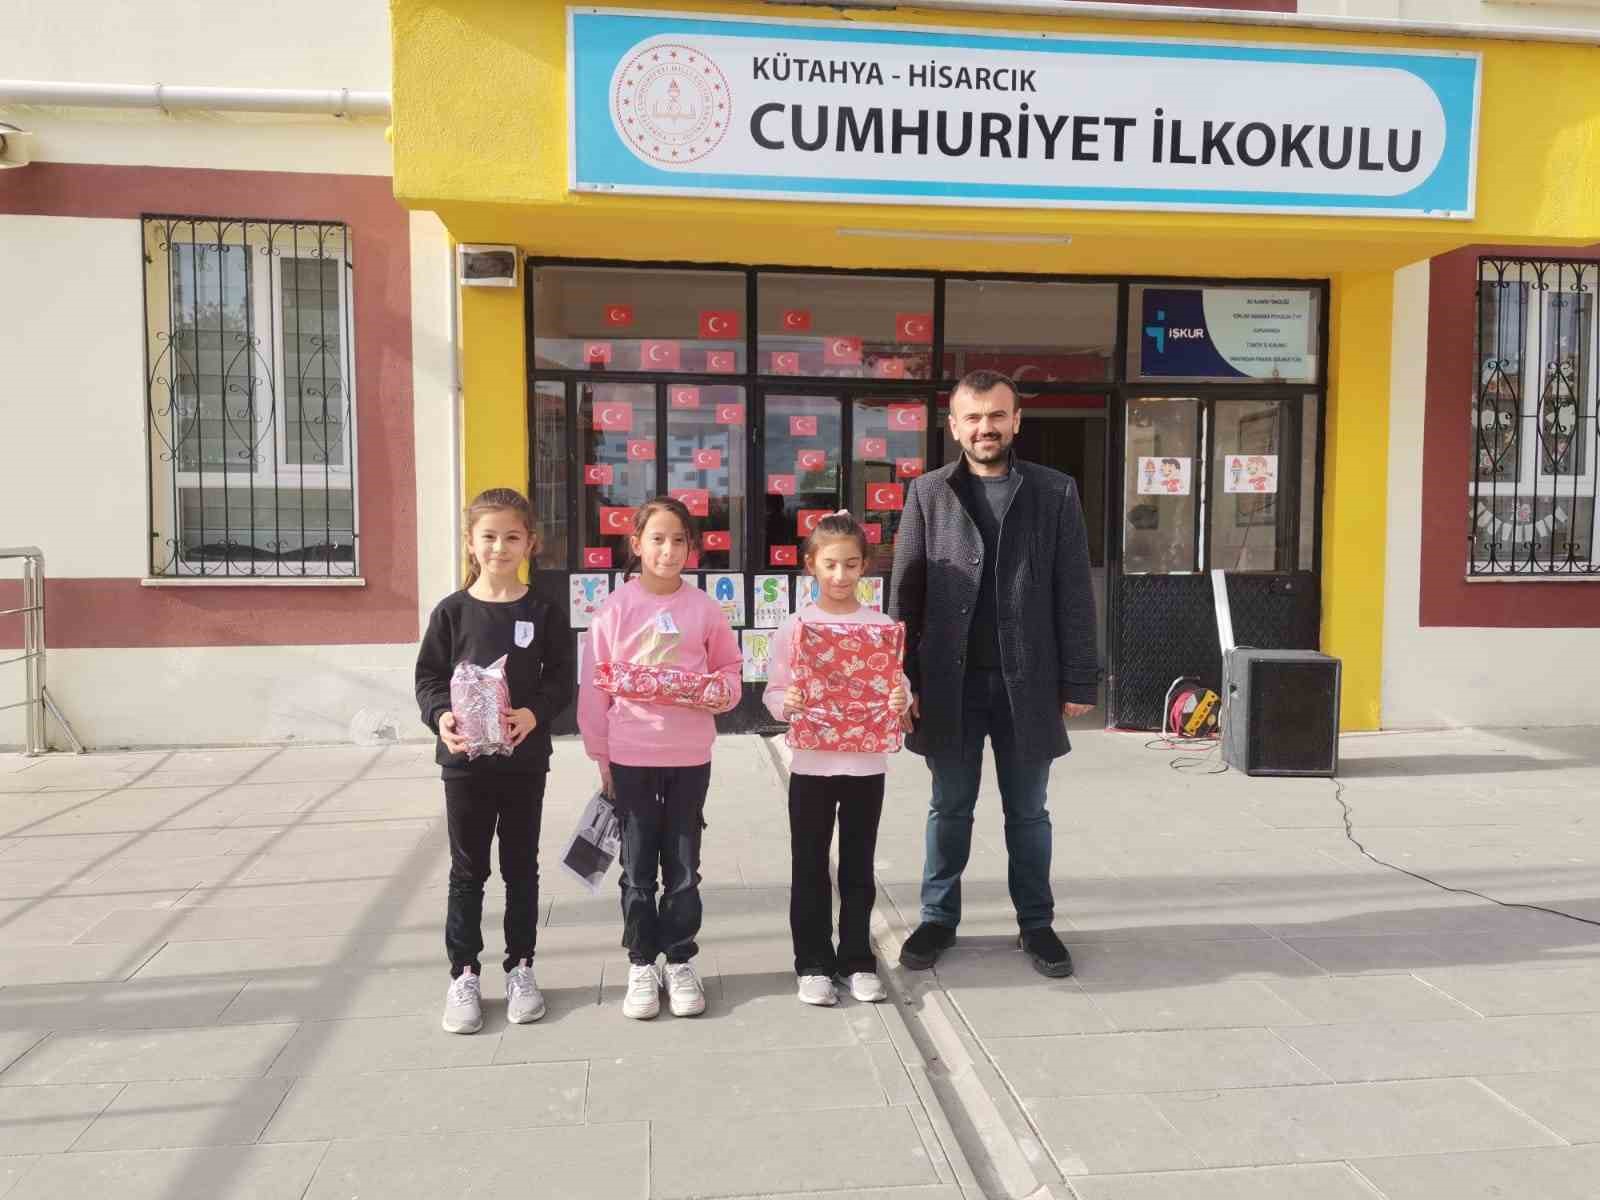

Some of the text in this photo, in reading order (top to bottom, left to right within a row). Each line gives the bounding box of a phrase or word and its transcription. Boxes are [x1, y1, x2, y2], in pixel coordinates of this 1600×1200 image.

[752, 52, 884, 85] KÜTAHYA
[908, 60, 1037, 92] HİSARCIK
[750, 101, 1137, 162] CUMHURİYET
[1152, 107, 1422, 173] İLKOKULU
